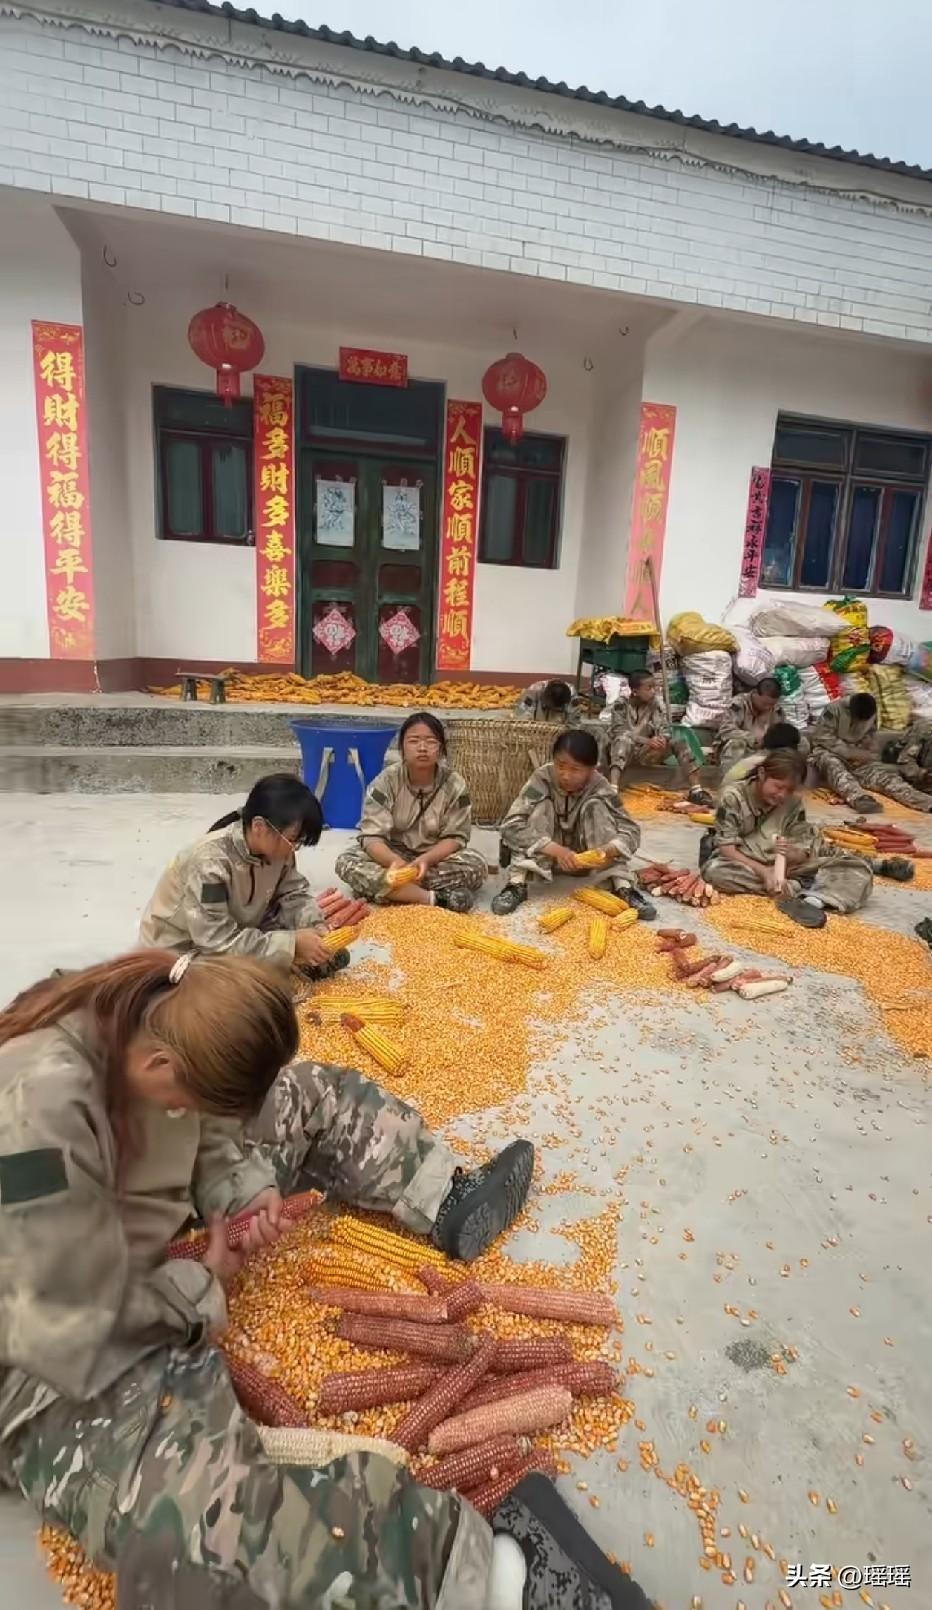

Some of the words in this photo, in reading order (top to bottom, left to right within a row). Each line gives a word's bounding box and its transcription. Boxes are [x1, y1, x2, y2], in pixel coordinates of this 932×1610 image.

[39, 350, 90, 622] 得財得福得平安
[259, 392, 292, 629] 福多財多喜樂多
[442, 417, 477, 643] 人順家順前程順
